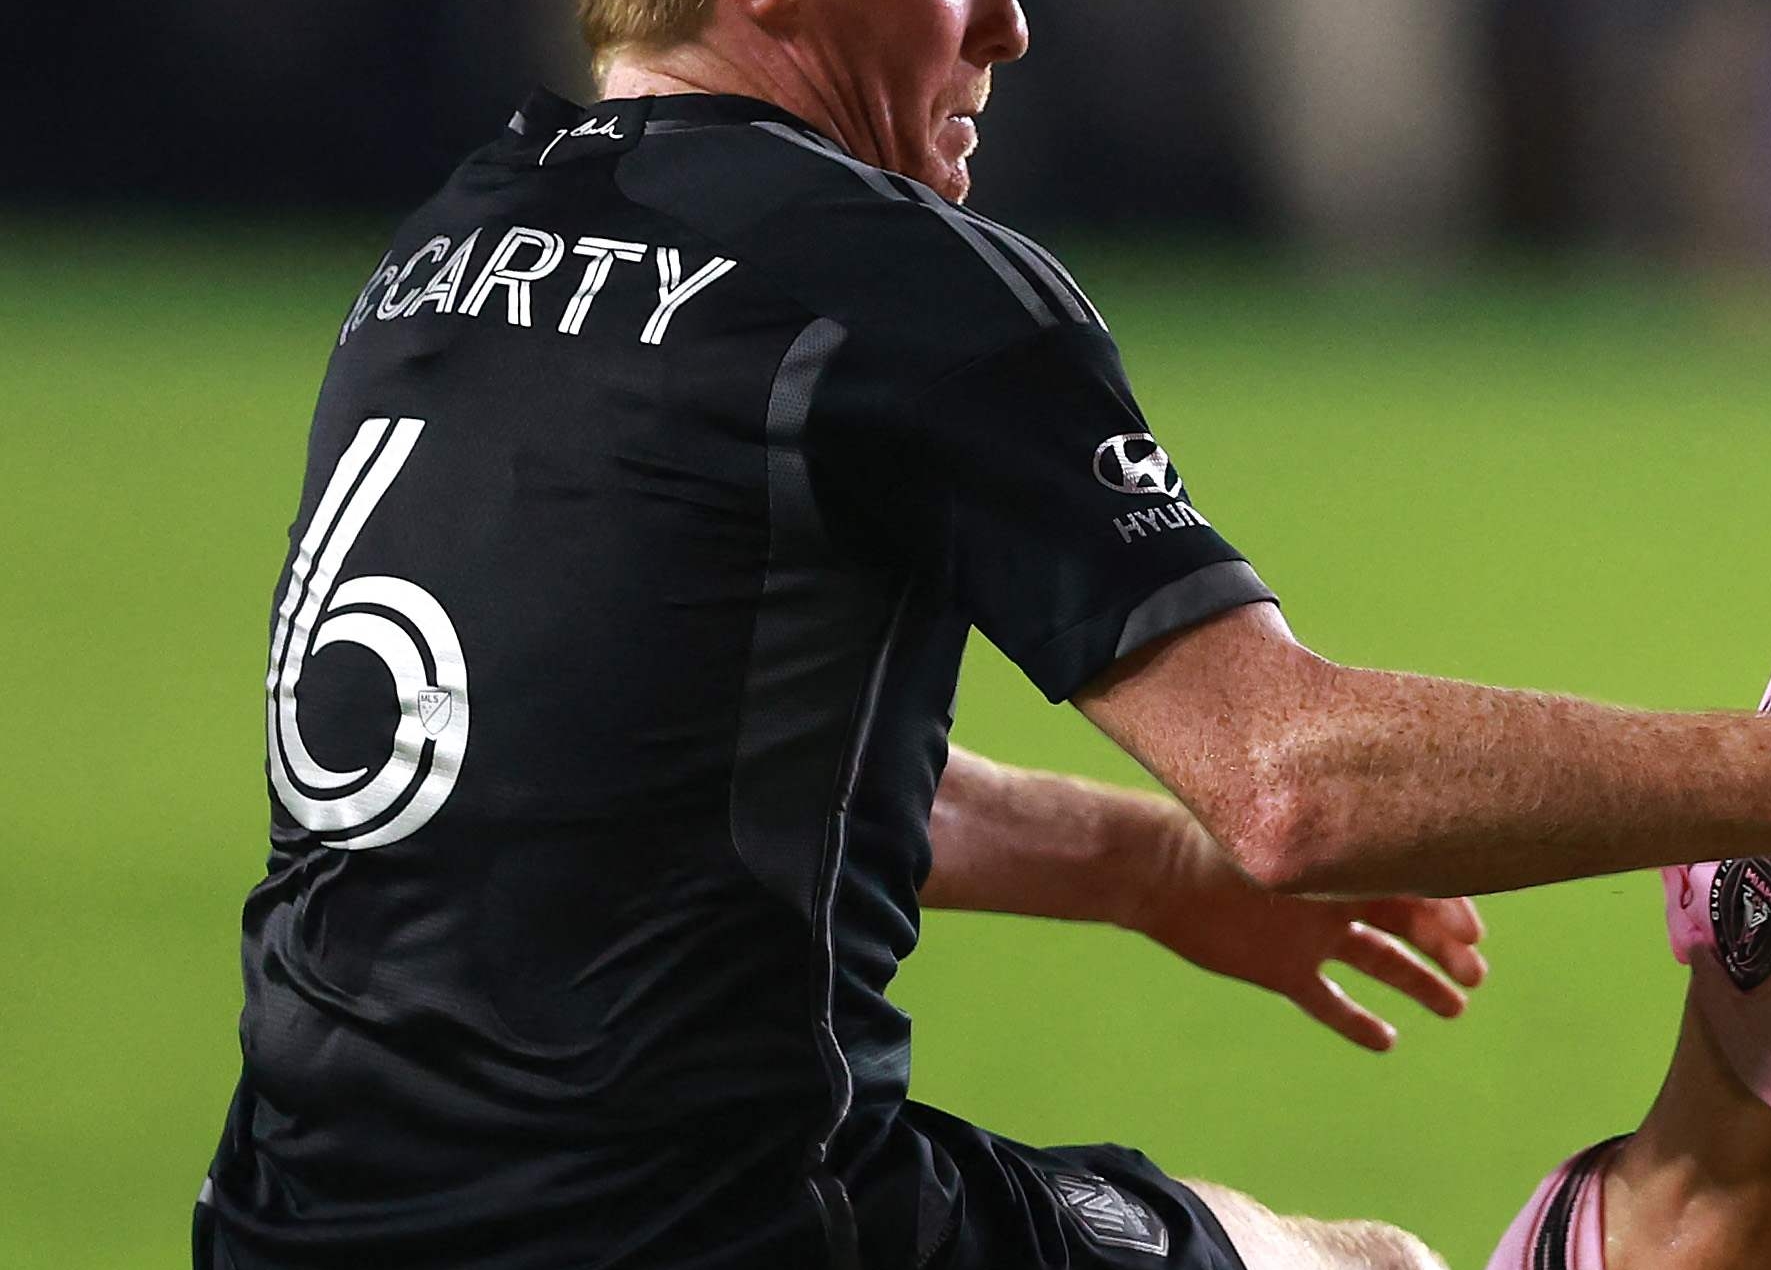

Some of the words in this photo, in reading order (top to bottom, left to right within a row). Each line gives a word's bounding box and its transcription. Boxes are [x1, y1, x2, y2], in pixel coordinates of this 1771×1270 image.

[340, 227, 738, 346] cCARTY
[267, 417, 469, 851] 6
[421, 694, 439, 703] MLS
